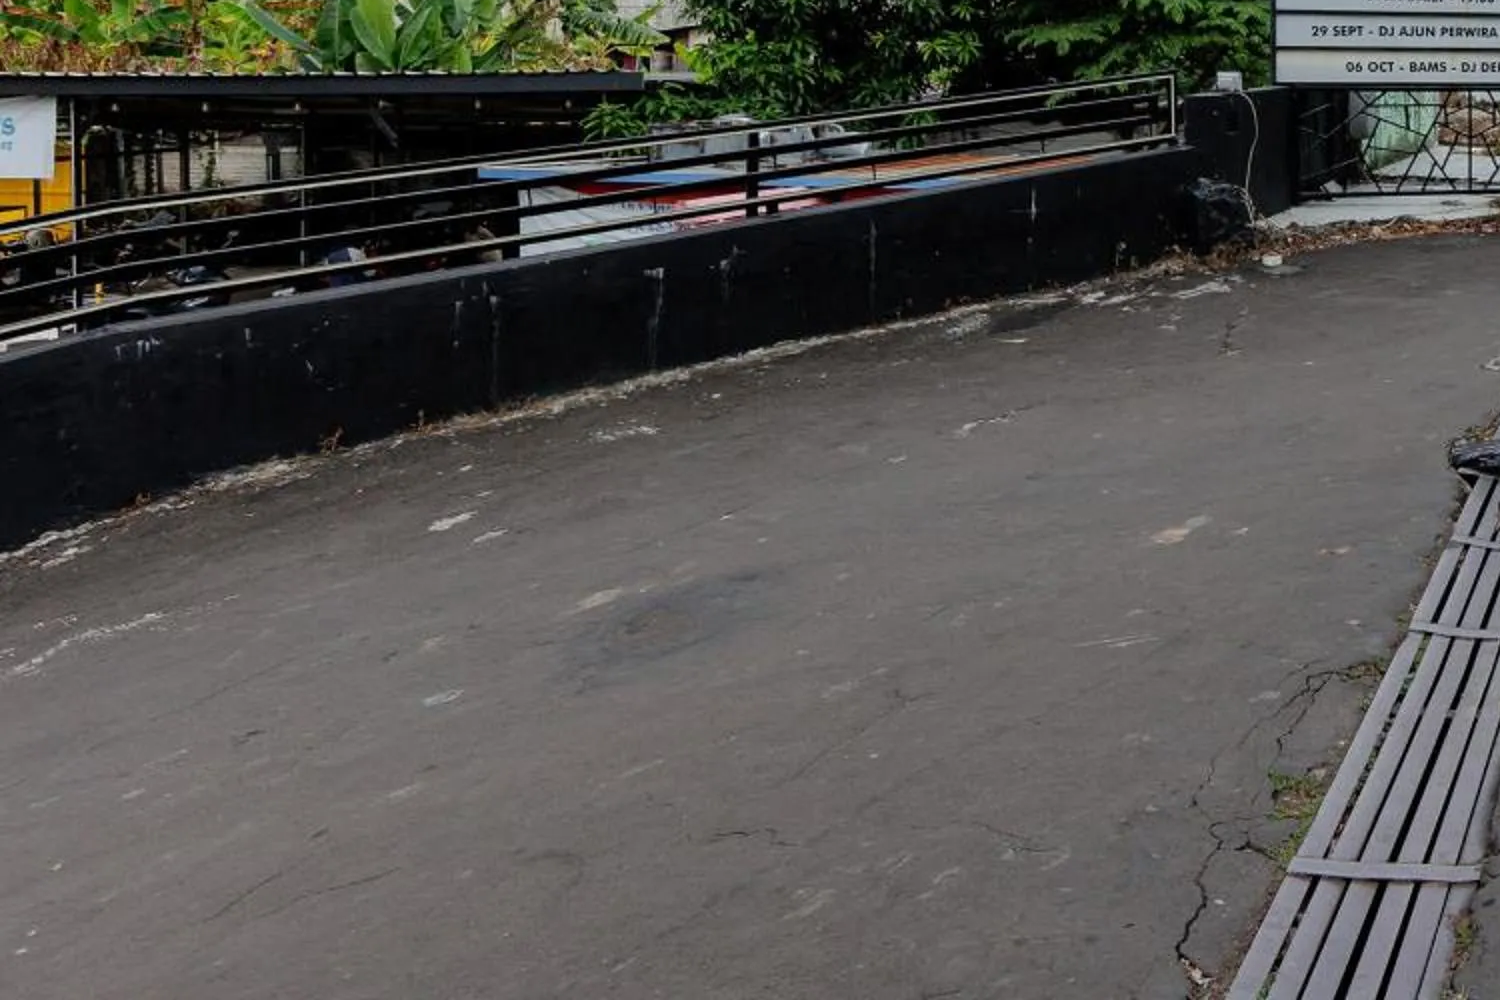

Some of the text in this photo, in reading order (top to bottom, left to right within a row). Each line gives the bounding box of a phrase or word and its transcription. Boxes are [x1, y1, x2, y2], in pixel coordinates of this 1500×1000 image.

[1311, 25, 1328, 37] 29
[1332, 25, 1364, 37] SEPT
[1379, 26, 1395, 37] DJ
[1399, 26, 1436, 37] AJUN
[1440, 26, 1499, 38] PERWIRA
[1345, 61, 1363, 73] 06
[1367, 61, 1395, 73] OCT
[1409, 61, 1447, 73] BAMS
[1461, 62, 1477, 73] DJ
